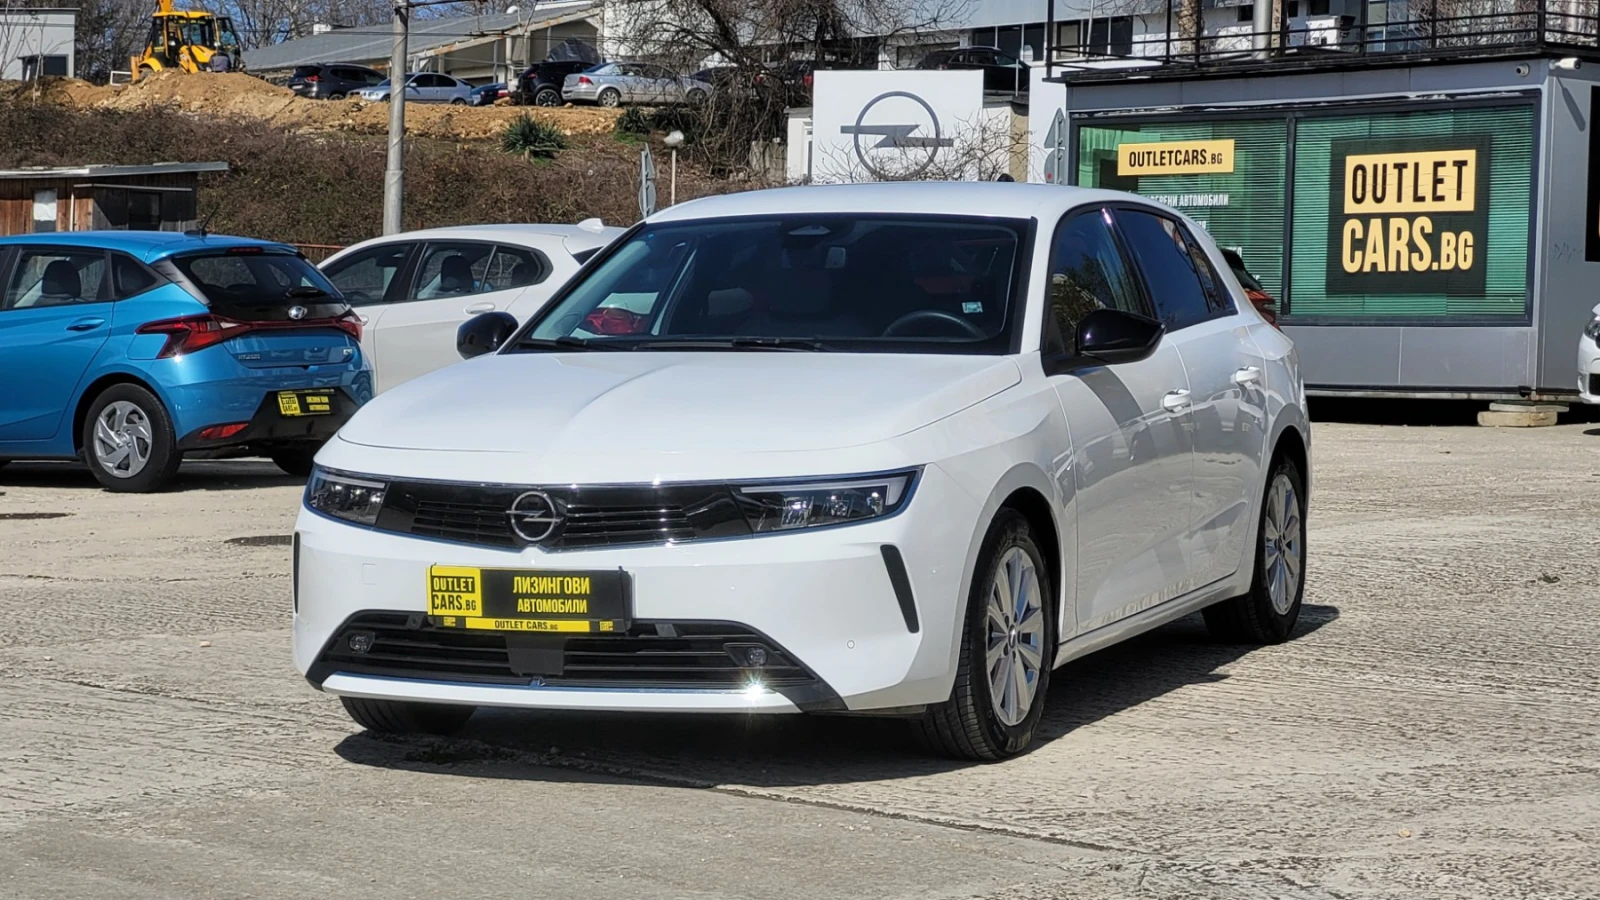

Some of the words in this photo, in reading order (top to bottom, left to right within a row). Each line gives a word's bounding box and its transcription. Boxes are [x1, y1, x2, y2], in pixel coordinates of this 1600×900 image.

[1129, 149, 1223, 167] OUTLETCARS.BG
[1352, 160, 1468, 204] OUTLET
[1179, 193, 1229, 207] АВТОМОБИЛИ
[1342, 216, 1474, 273] CARS.BG
[433, 577, 474, 592] OUTLET
[512, 576, 591, 594] ЛИЗИНГОВИ
[432, 594, 477, 612] CARS.BG
[517, 598, 588, 614] АВТОМОБИЛИ
[494, 620, 523, 630] OUTLET
[526, 621, 559, 631] CARS.BG
